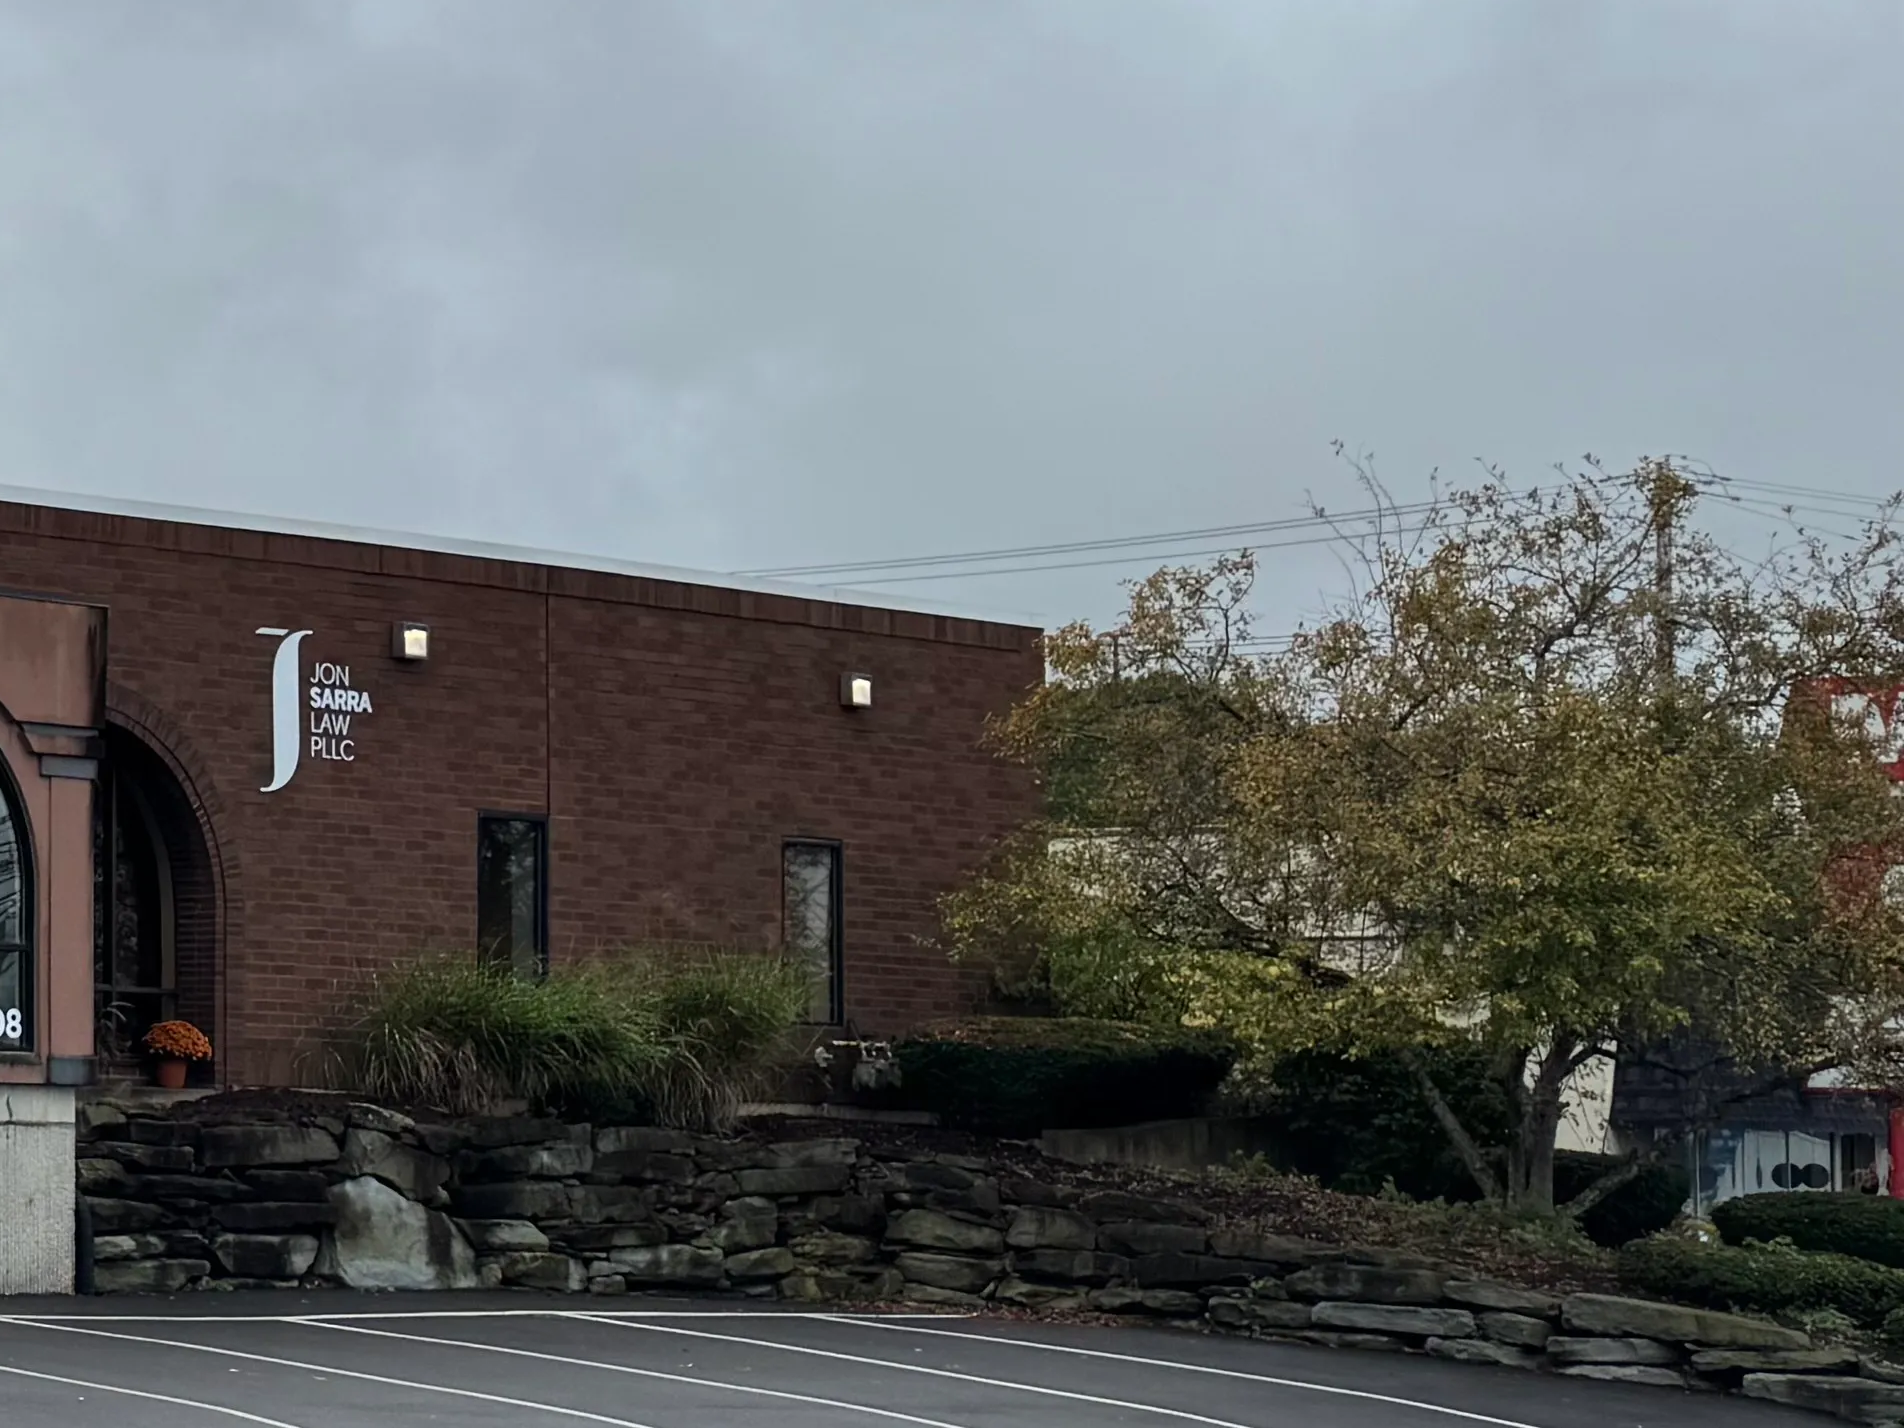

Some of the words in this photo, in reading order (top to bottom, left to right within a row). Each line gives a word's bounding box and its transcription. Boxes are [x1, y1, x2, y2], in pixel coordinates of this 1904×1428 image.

[309, 662, 350, 687] JON
[309, 686, 373, 713] SARRA
[310, 711, 351, 736] LAW
[310, 736, 355, 761] PLLC
